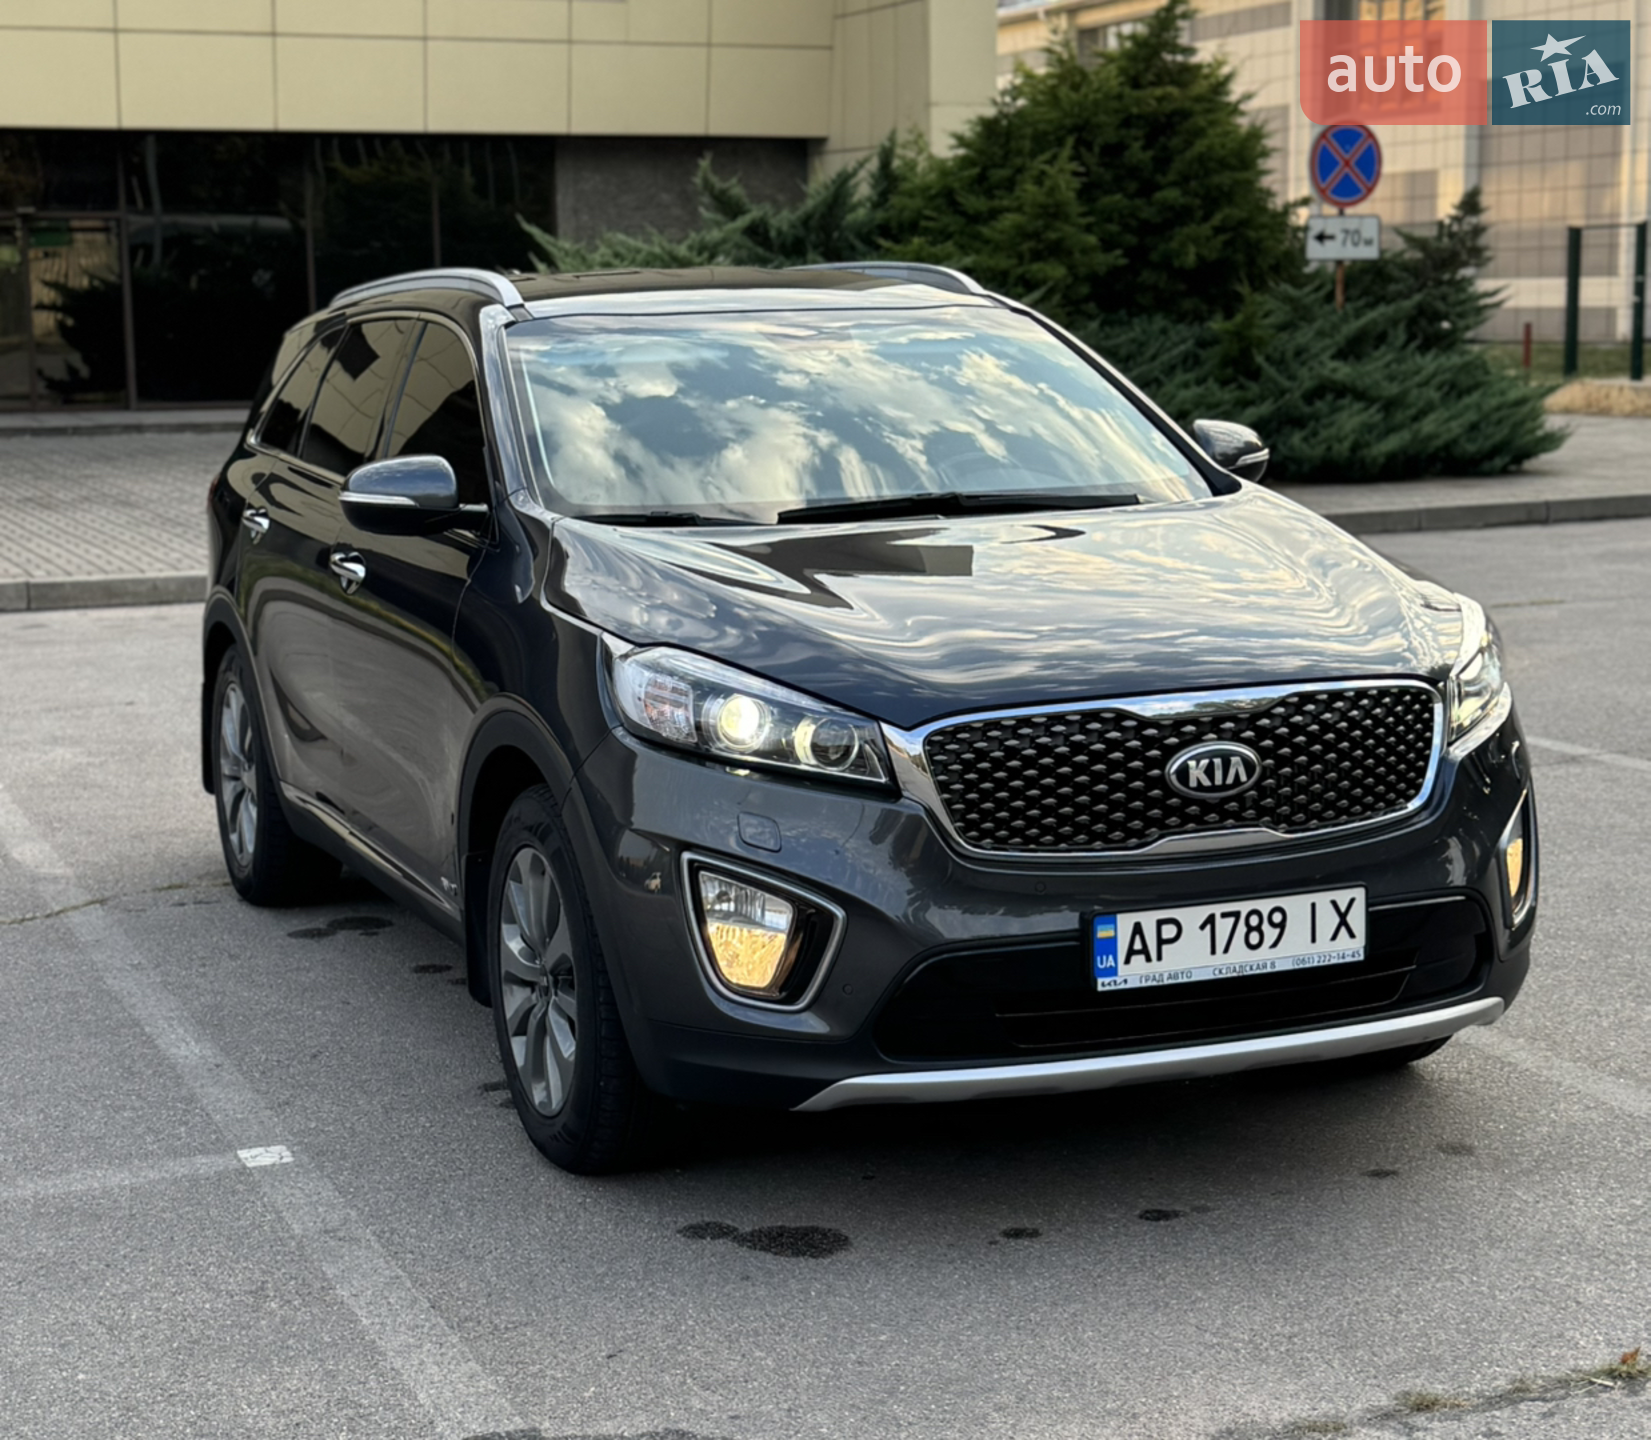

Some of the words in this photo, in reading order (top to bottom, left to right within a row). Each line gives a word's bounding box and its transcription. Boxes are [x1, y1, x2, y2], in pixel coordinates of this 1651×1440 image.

[1187, 756, 1248, 788] KIA
[1123, 917, 1183, 965] AP
[1199, 906, 1288, 956] 1789
[1097, 955, 1116, 969] UA
[1139, 973, 1164, 985] ГРАД
[1166, 971, 1193, 982] АВТО
[1212, 962, 1268, 976] СКЛАДСКАЯ
[1269, 961, 1276, 970] 8
